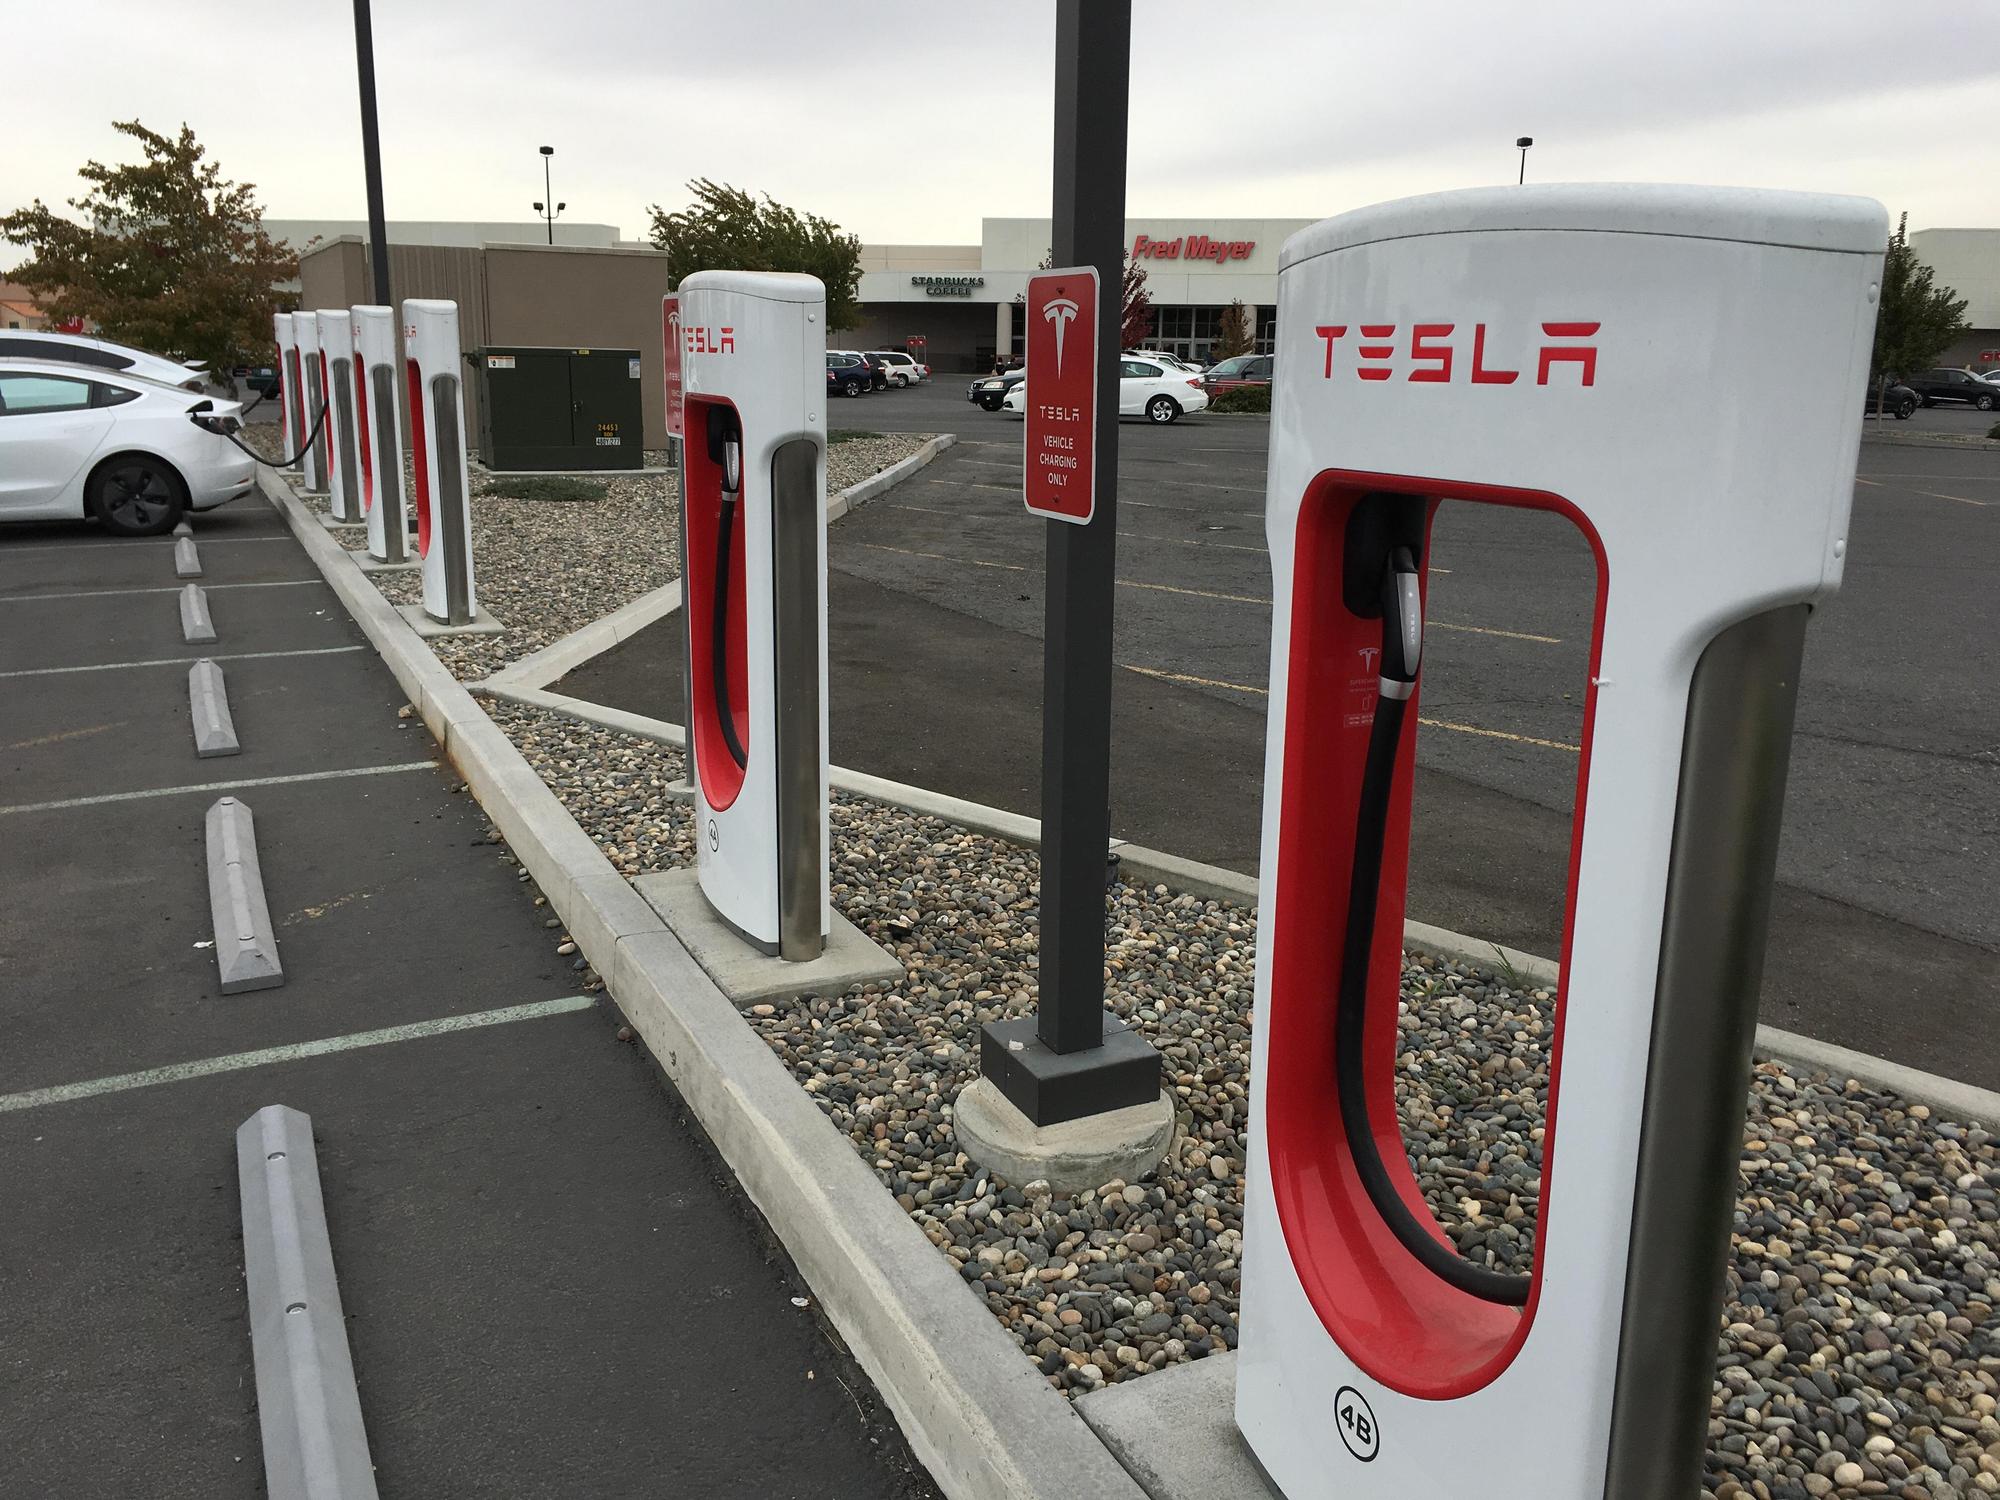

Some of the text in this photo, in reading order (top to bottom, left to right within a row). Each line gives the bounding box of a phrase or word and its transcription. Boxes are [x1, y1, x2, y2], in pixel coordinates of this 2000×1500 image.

[1132, 235, 1255, 264] Fred Meyer
[911, 276, 985, 288] STARBUCKS
[926, 287, 972, 297] COFFEE
[1315, 322, 1601, 387] TESLA
[1040, 405, 1079, 421] TESLA
[1043, 435, 1074, 450] VEHICLE
[1040, 453, 1077, 469] CHARGING
[1047, 472, 1068, 486] ONLY
[1340, 1404, 1371, 1445] 4B
